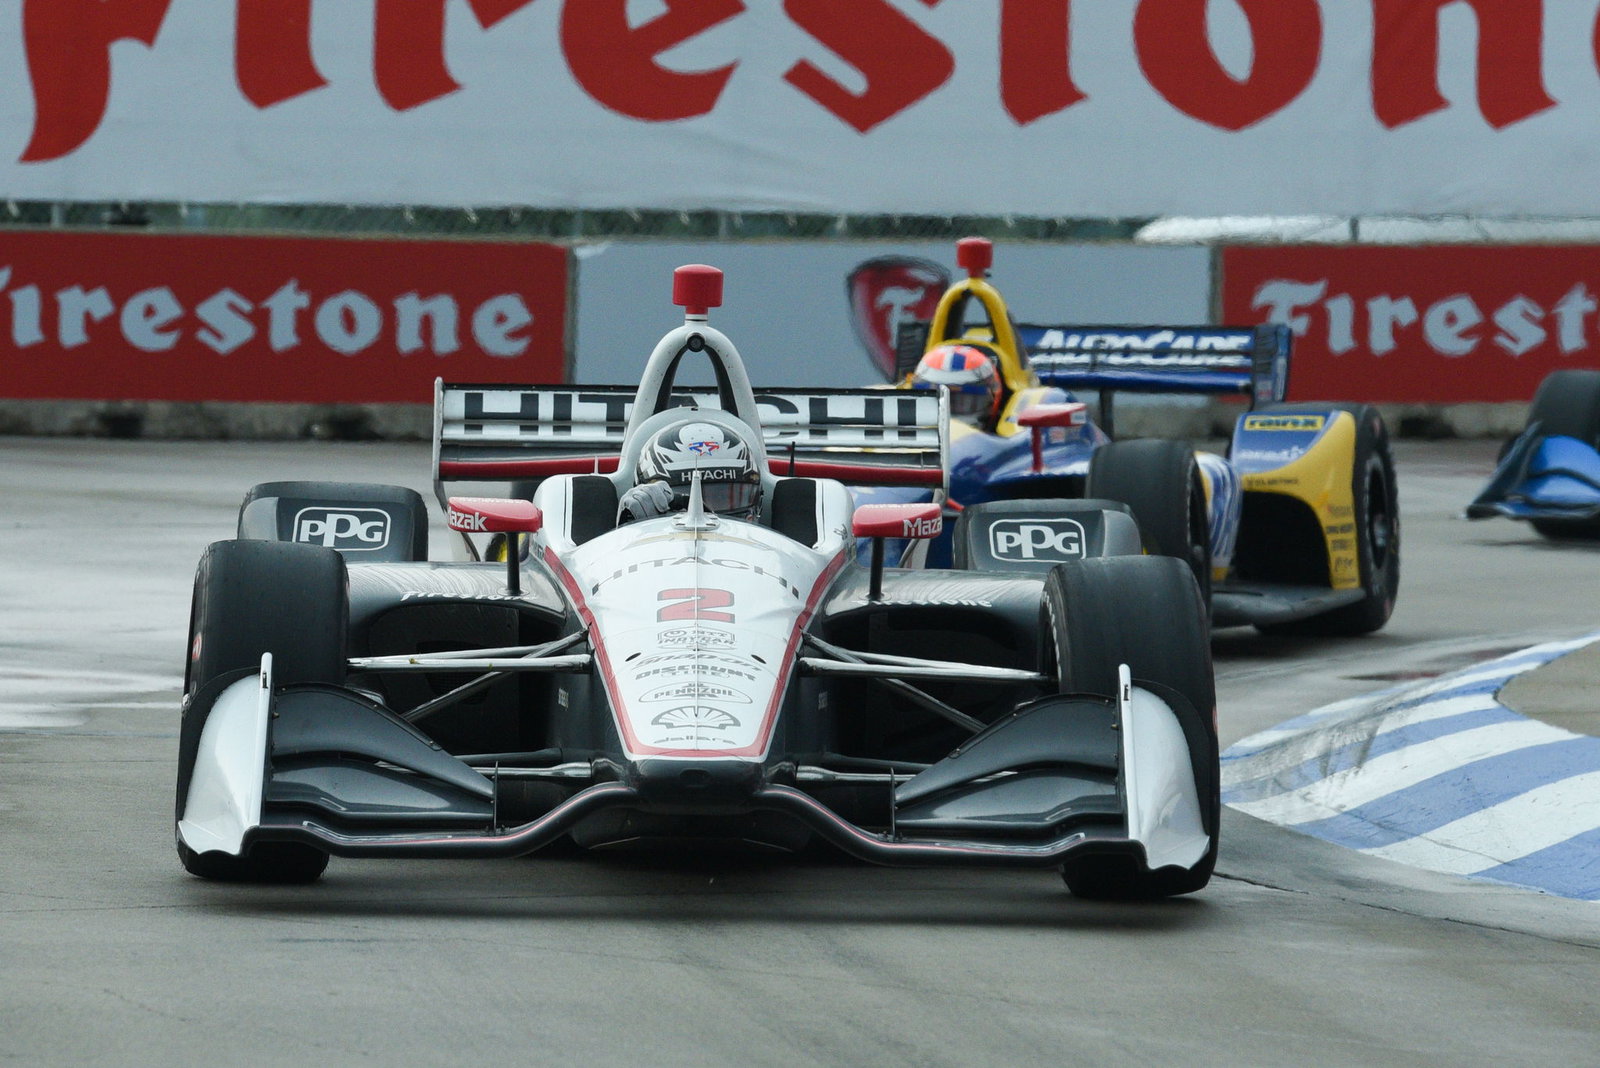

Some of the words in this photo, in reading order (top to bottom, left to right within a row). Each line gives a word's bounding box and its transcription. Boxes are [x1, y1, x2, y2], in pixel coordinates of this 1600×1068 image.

[0, 265, 533, 355] irestone
[1251, 279, 1600, 356] Firest
[681, 469, 737, 482] HTACHI
[300, 514, 385, 549] PPG
[996, 525, 1080, 558] PPG
[591, 556, 799, 599] HITACHI
[657, 588, 735, 623] 2
[635, 664, 756, 681] DISCOUNT
[654, 687, 734, 699] PENNZOIL
